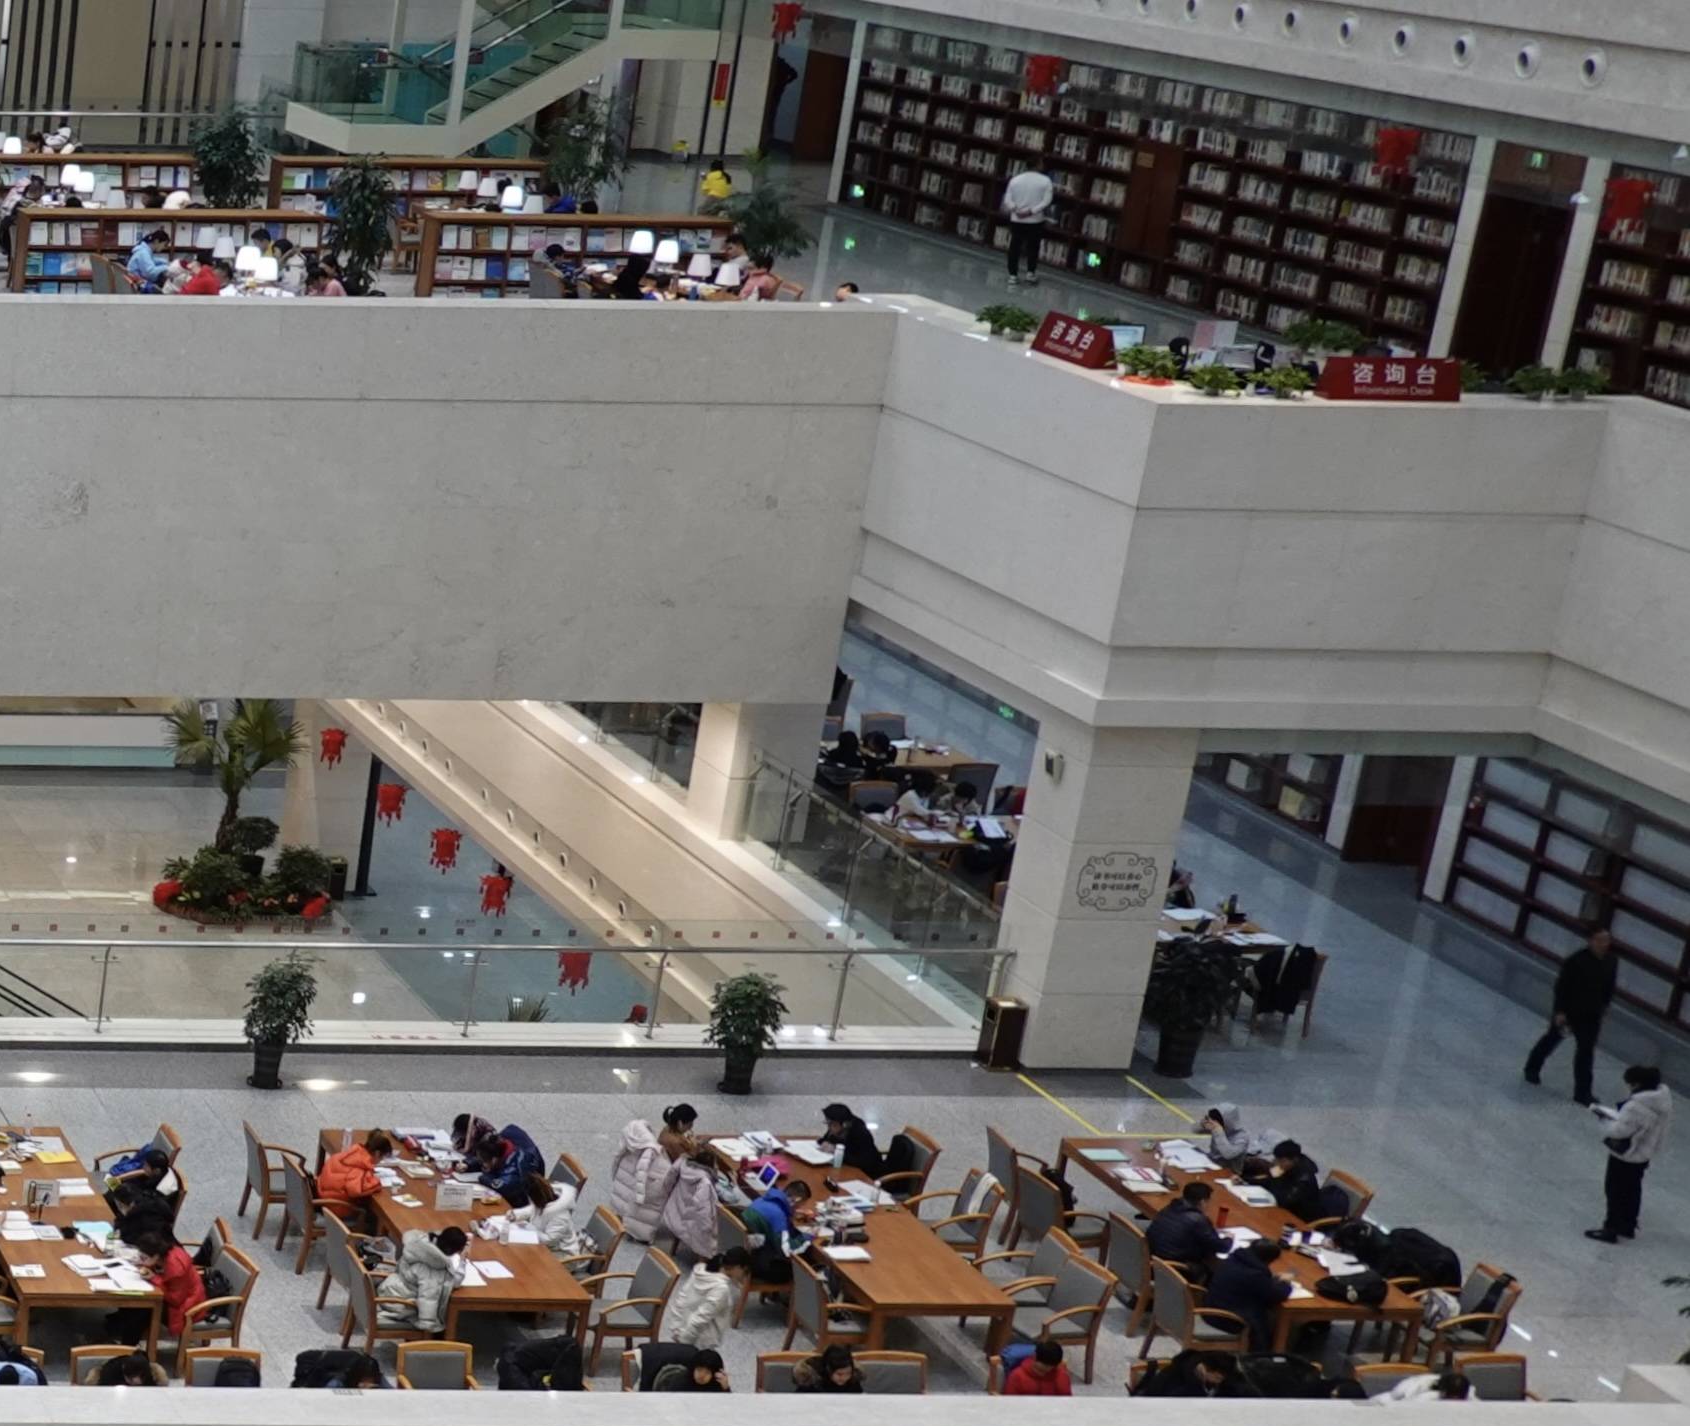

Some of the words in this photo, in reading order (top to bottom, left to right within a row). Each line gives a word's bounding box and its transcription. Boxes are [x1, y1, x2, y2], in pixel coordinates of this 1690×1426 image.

[1050, 319, 1096, 351] 咨询台
[1352, 363, 1437, 385] 咨询台
[1354, 386, 1409, 397] Information
[1410, 386, 1436, 397] Desk
